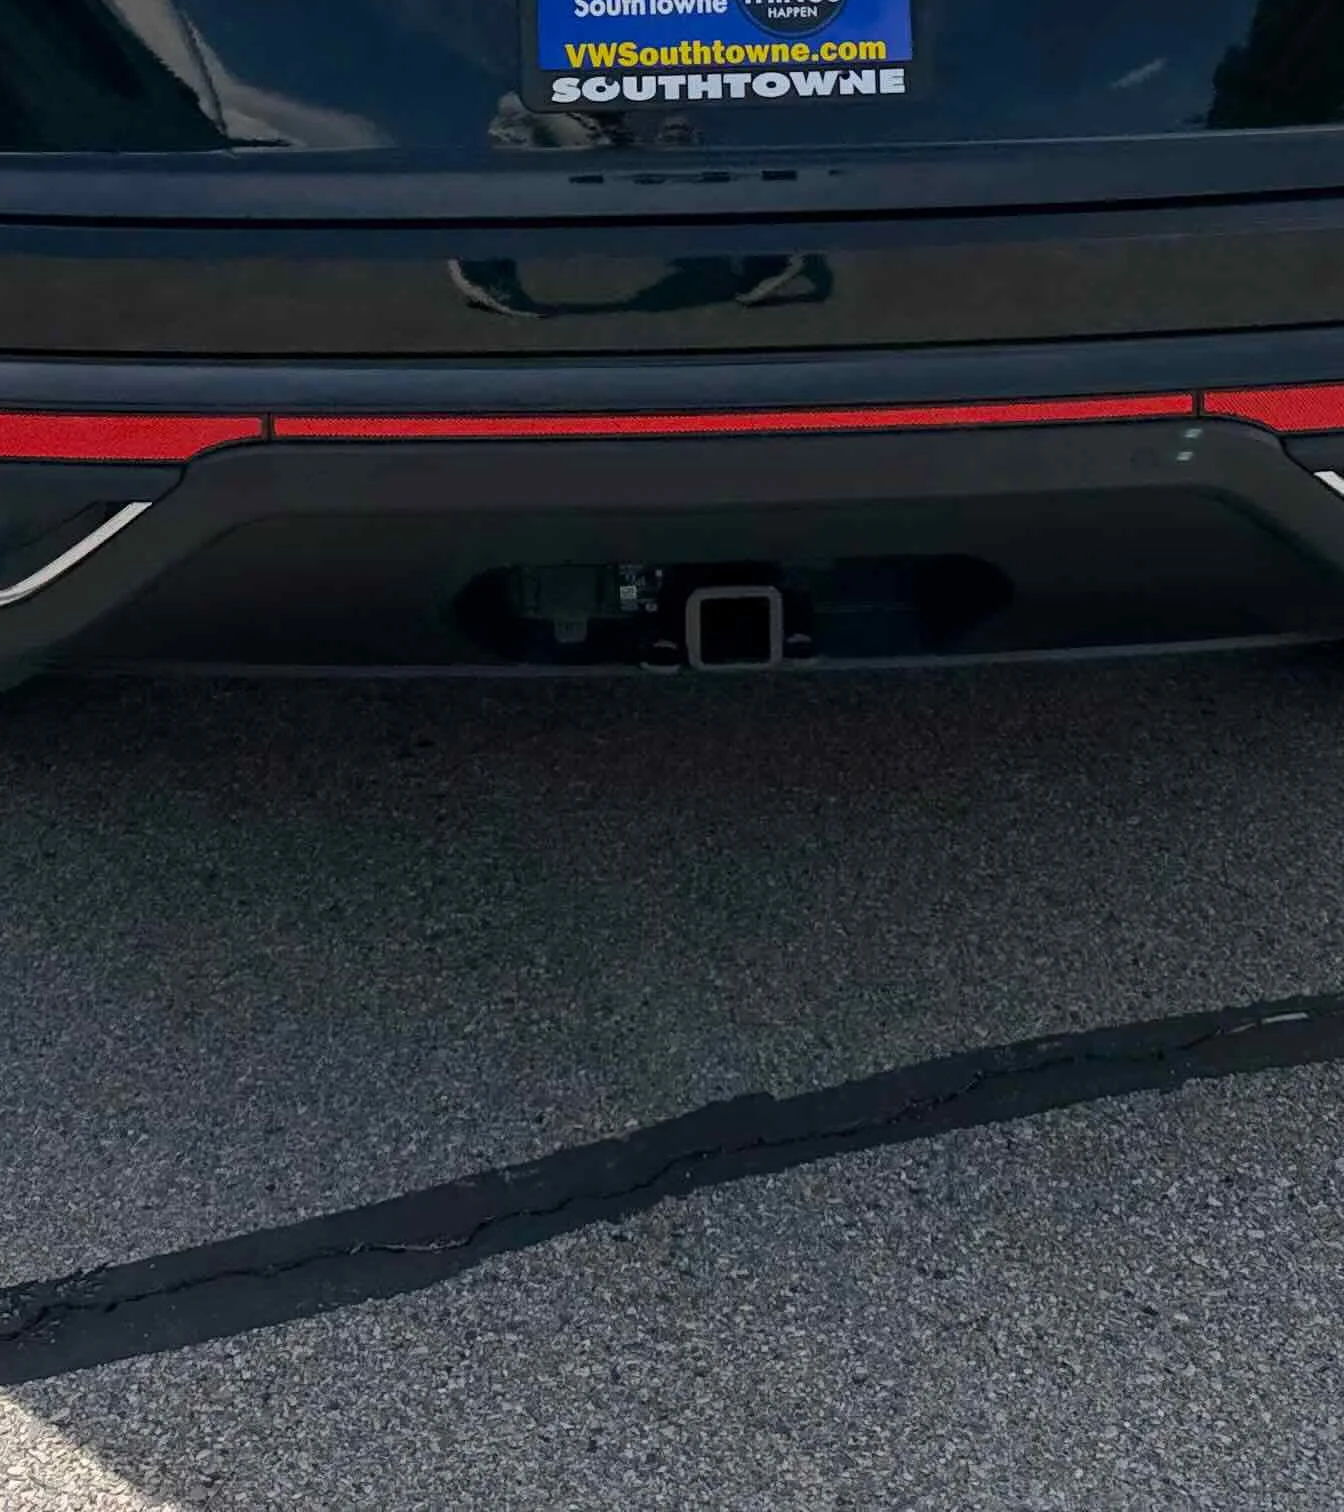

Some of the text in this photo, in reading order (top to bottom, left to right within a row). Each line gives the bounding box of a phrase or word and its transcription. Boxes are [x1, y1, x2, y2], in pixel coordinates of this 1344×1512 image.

[767, 5, 818, 19] HAPPEN
[564, 39, 887, 68] VWSouthtowne.com
[551, 68, 906, 103] SOUTHTOWNE
